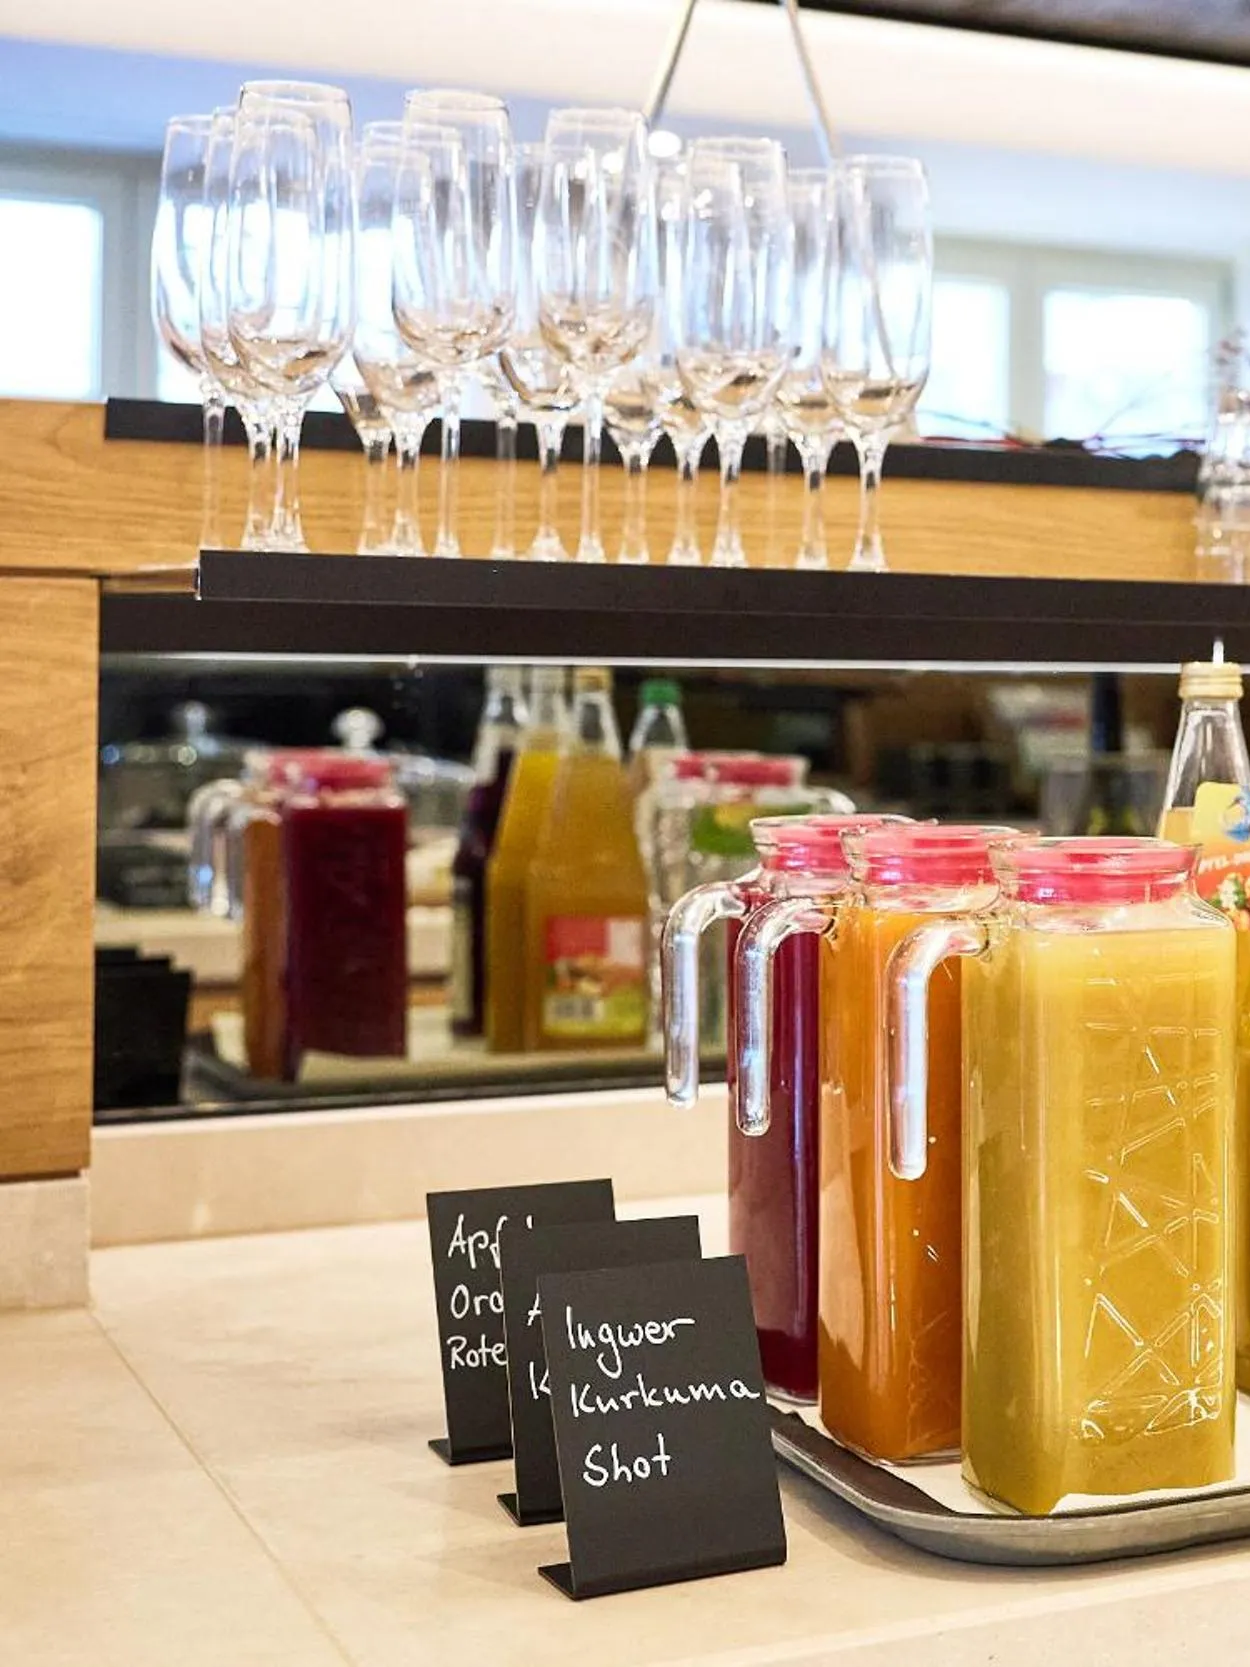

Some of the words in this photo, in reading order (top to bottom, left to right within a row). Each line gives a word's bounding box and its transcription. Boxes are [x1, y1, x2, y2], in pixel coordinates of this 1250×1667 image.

[565, 1305, 696, 1380] Ingwer
[570, 1372, 761, 1418] Kurkuma
[582, 1432, 672, 1487] Shot
